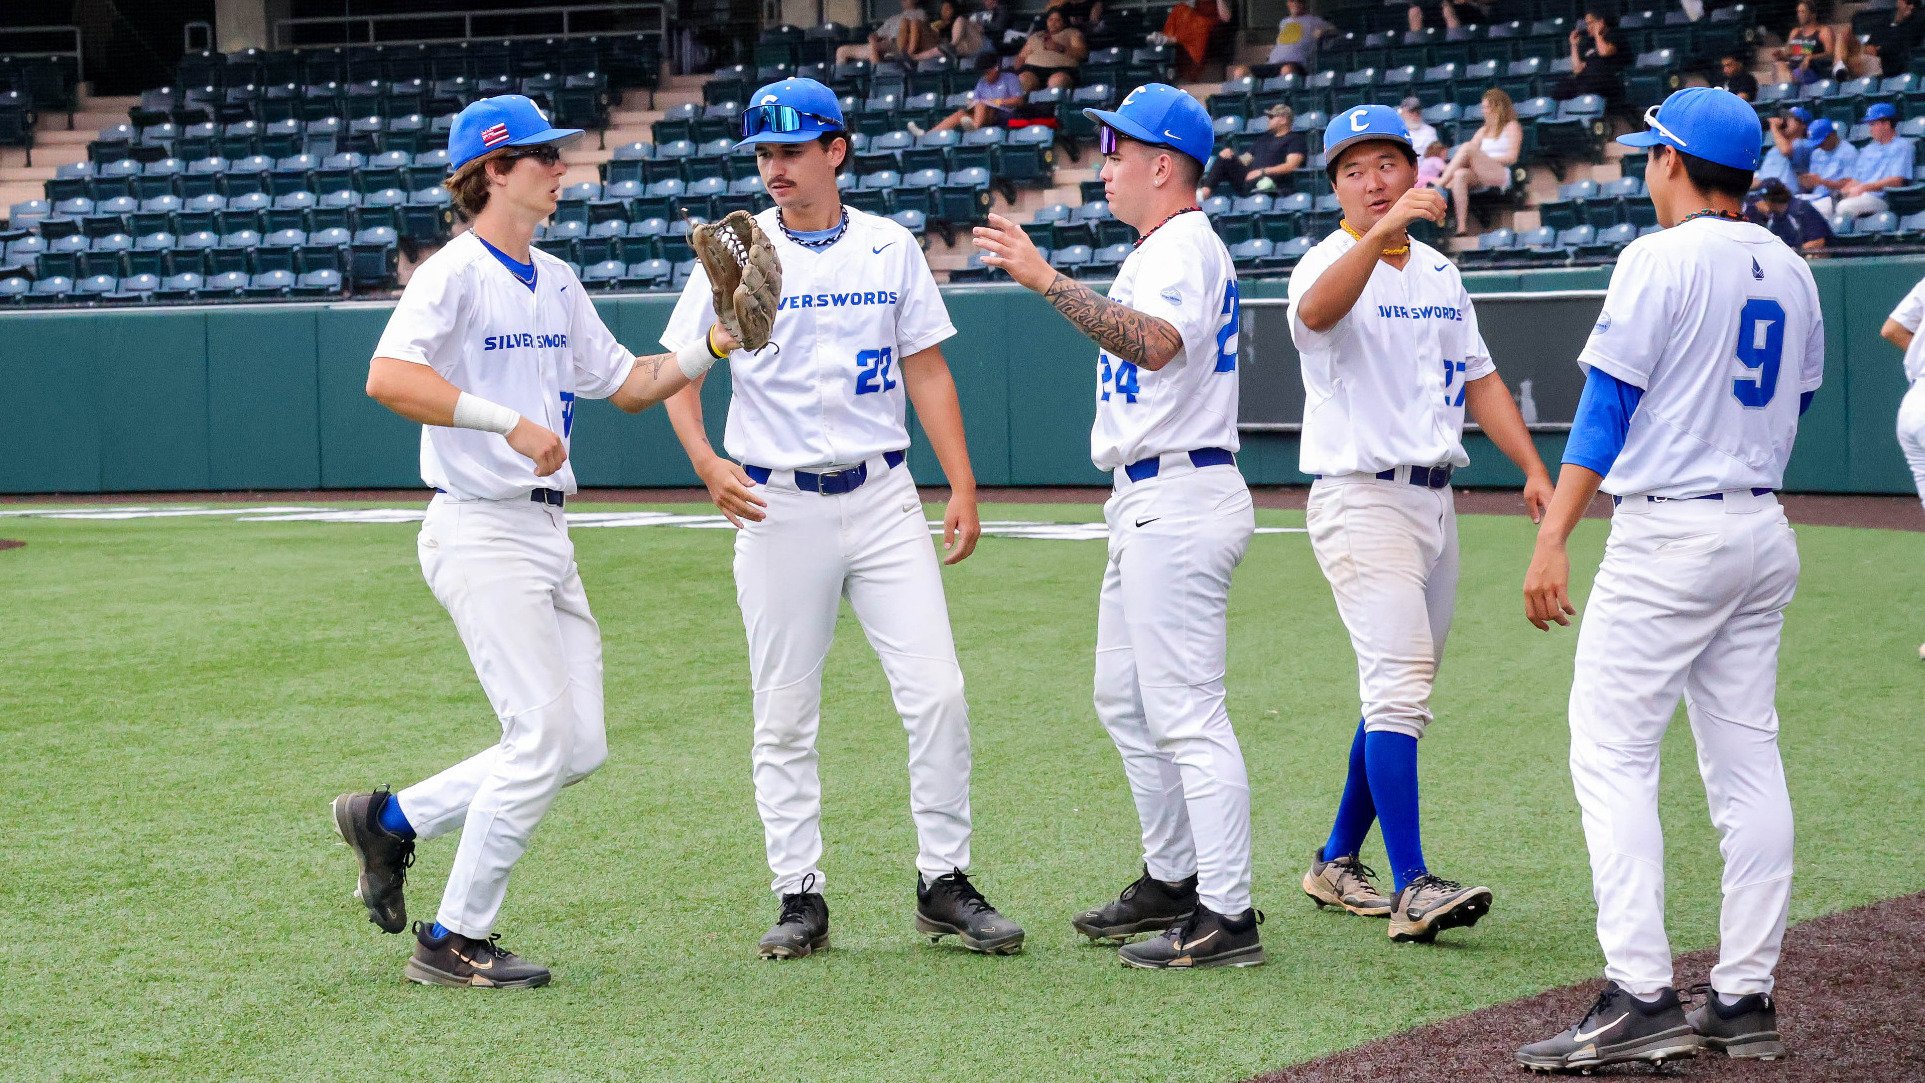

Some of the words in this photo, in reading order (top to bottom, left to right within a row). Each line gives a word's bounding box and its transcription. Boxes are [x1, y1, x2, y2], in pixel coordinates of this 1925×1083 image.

[1348, 109, 1370, 132] C
[856, 346, 897, 395] 22
[1731, 296, 1786, 410] 9
